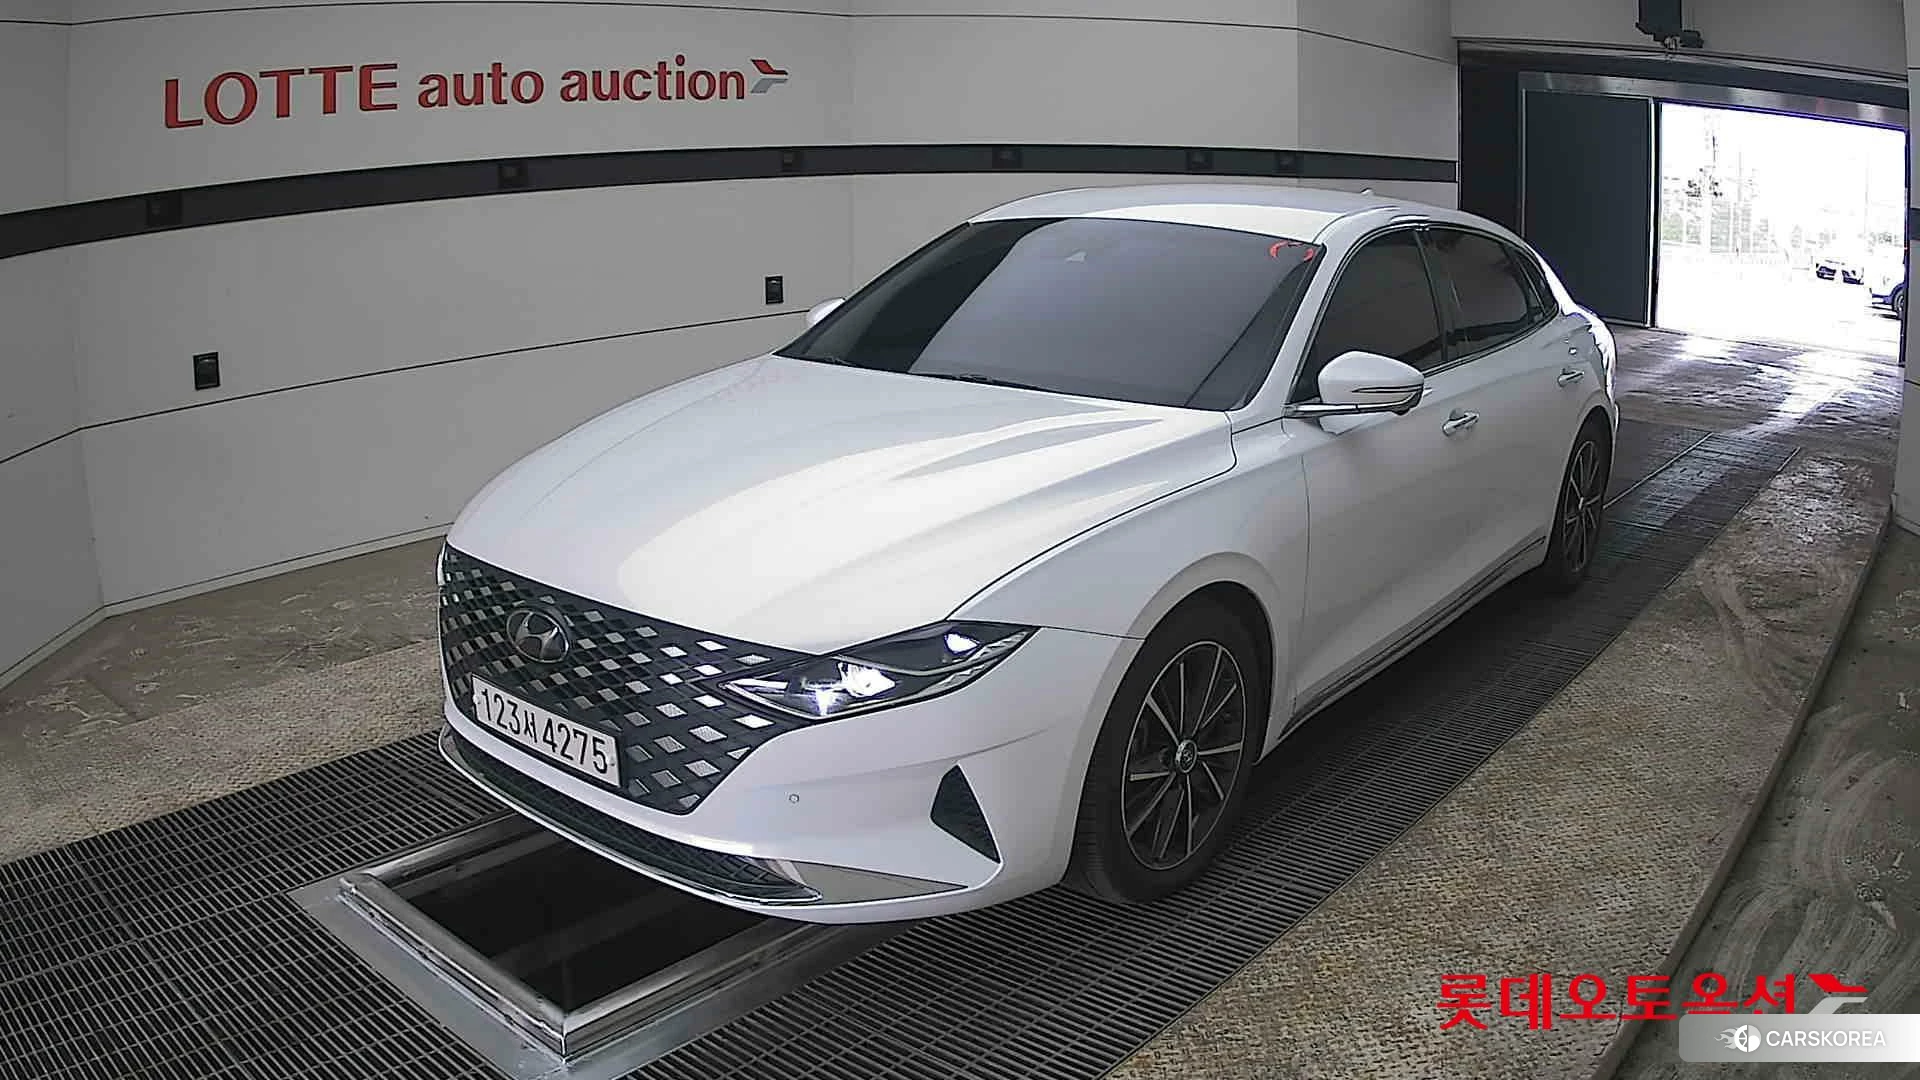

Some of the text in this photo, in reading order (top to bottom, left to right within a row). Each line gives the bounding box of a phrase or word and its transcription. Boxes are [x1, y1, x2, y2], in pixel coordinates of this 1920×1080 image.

[164, 54, 746, 129] LOTTE auto auction
